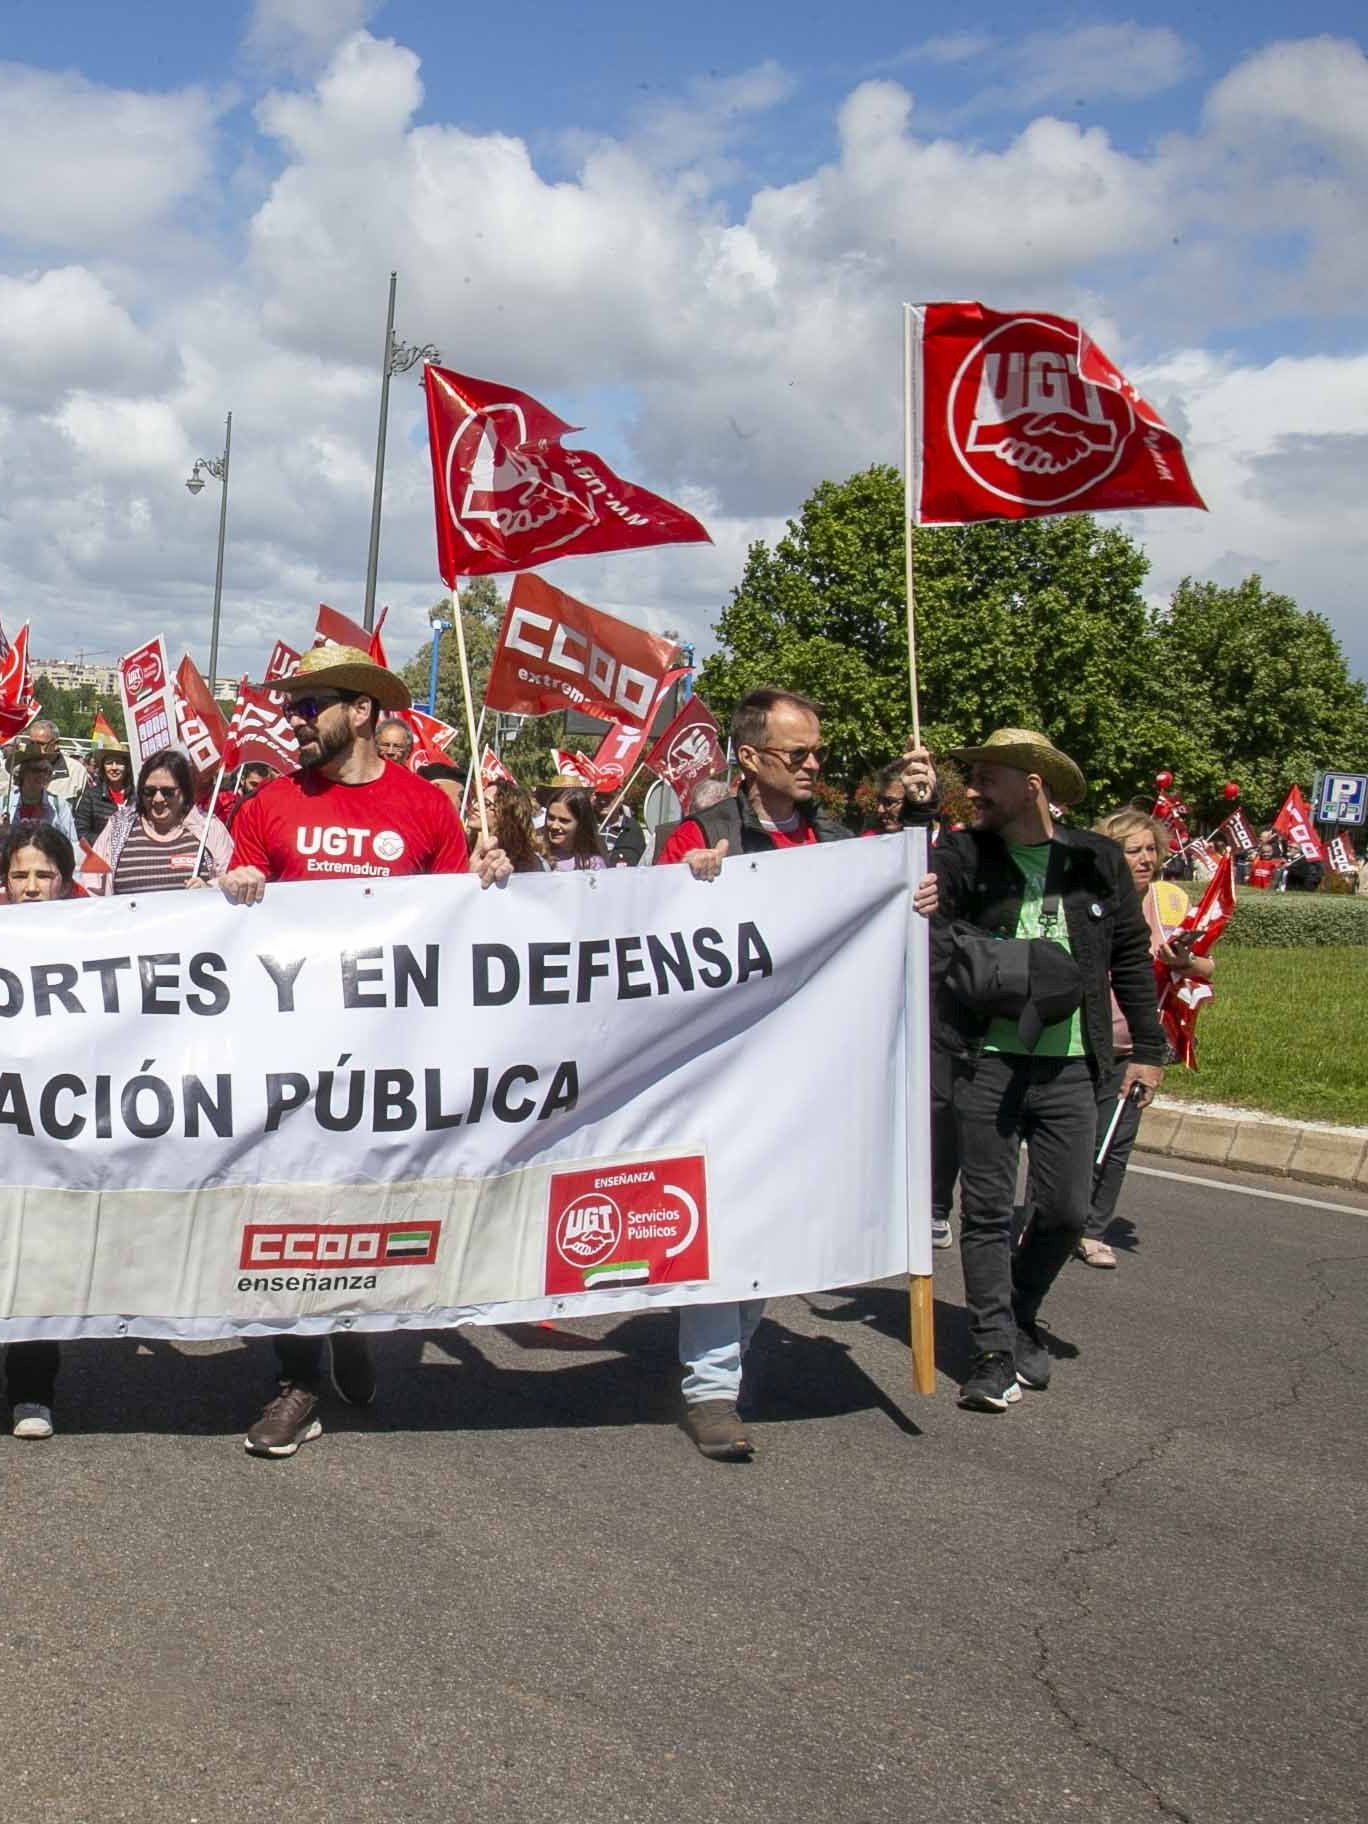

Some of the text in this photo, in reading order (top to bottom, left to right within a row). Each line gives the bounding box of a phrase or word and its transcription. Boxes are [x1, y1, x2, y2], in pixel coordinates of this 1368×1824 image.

[505, 606, 658, 721] CCOO
[1332, 779, 1358, 803] P
[296, 826, 370, 857] UGT
[307, 858, 390, 878] Extremadura
[257, 953, 308, 1013] Y
[340, 943, 440, 1009] EN
[472, 920, 774, 1006] DEFENSA
[264, 1052, 580, 1132] PÚBLICA
[594, 1170, 657, 1190] ENSEÑANZA
[565, 1205, 613, 1237] UGT
[627, 1208, 681, 1226] Servicios
[627, 1223, 678, 1241] Públicos
[250, 1232, 380, 1263] CCOO
[237, 1271, 378, 1293] enseñanza
